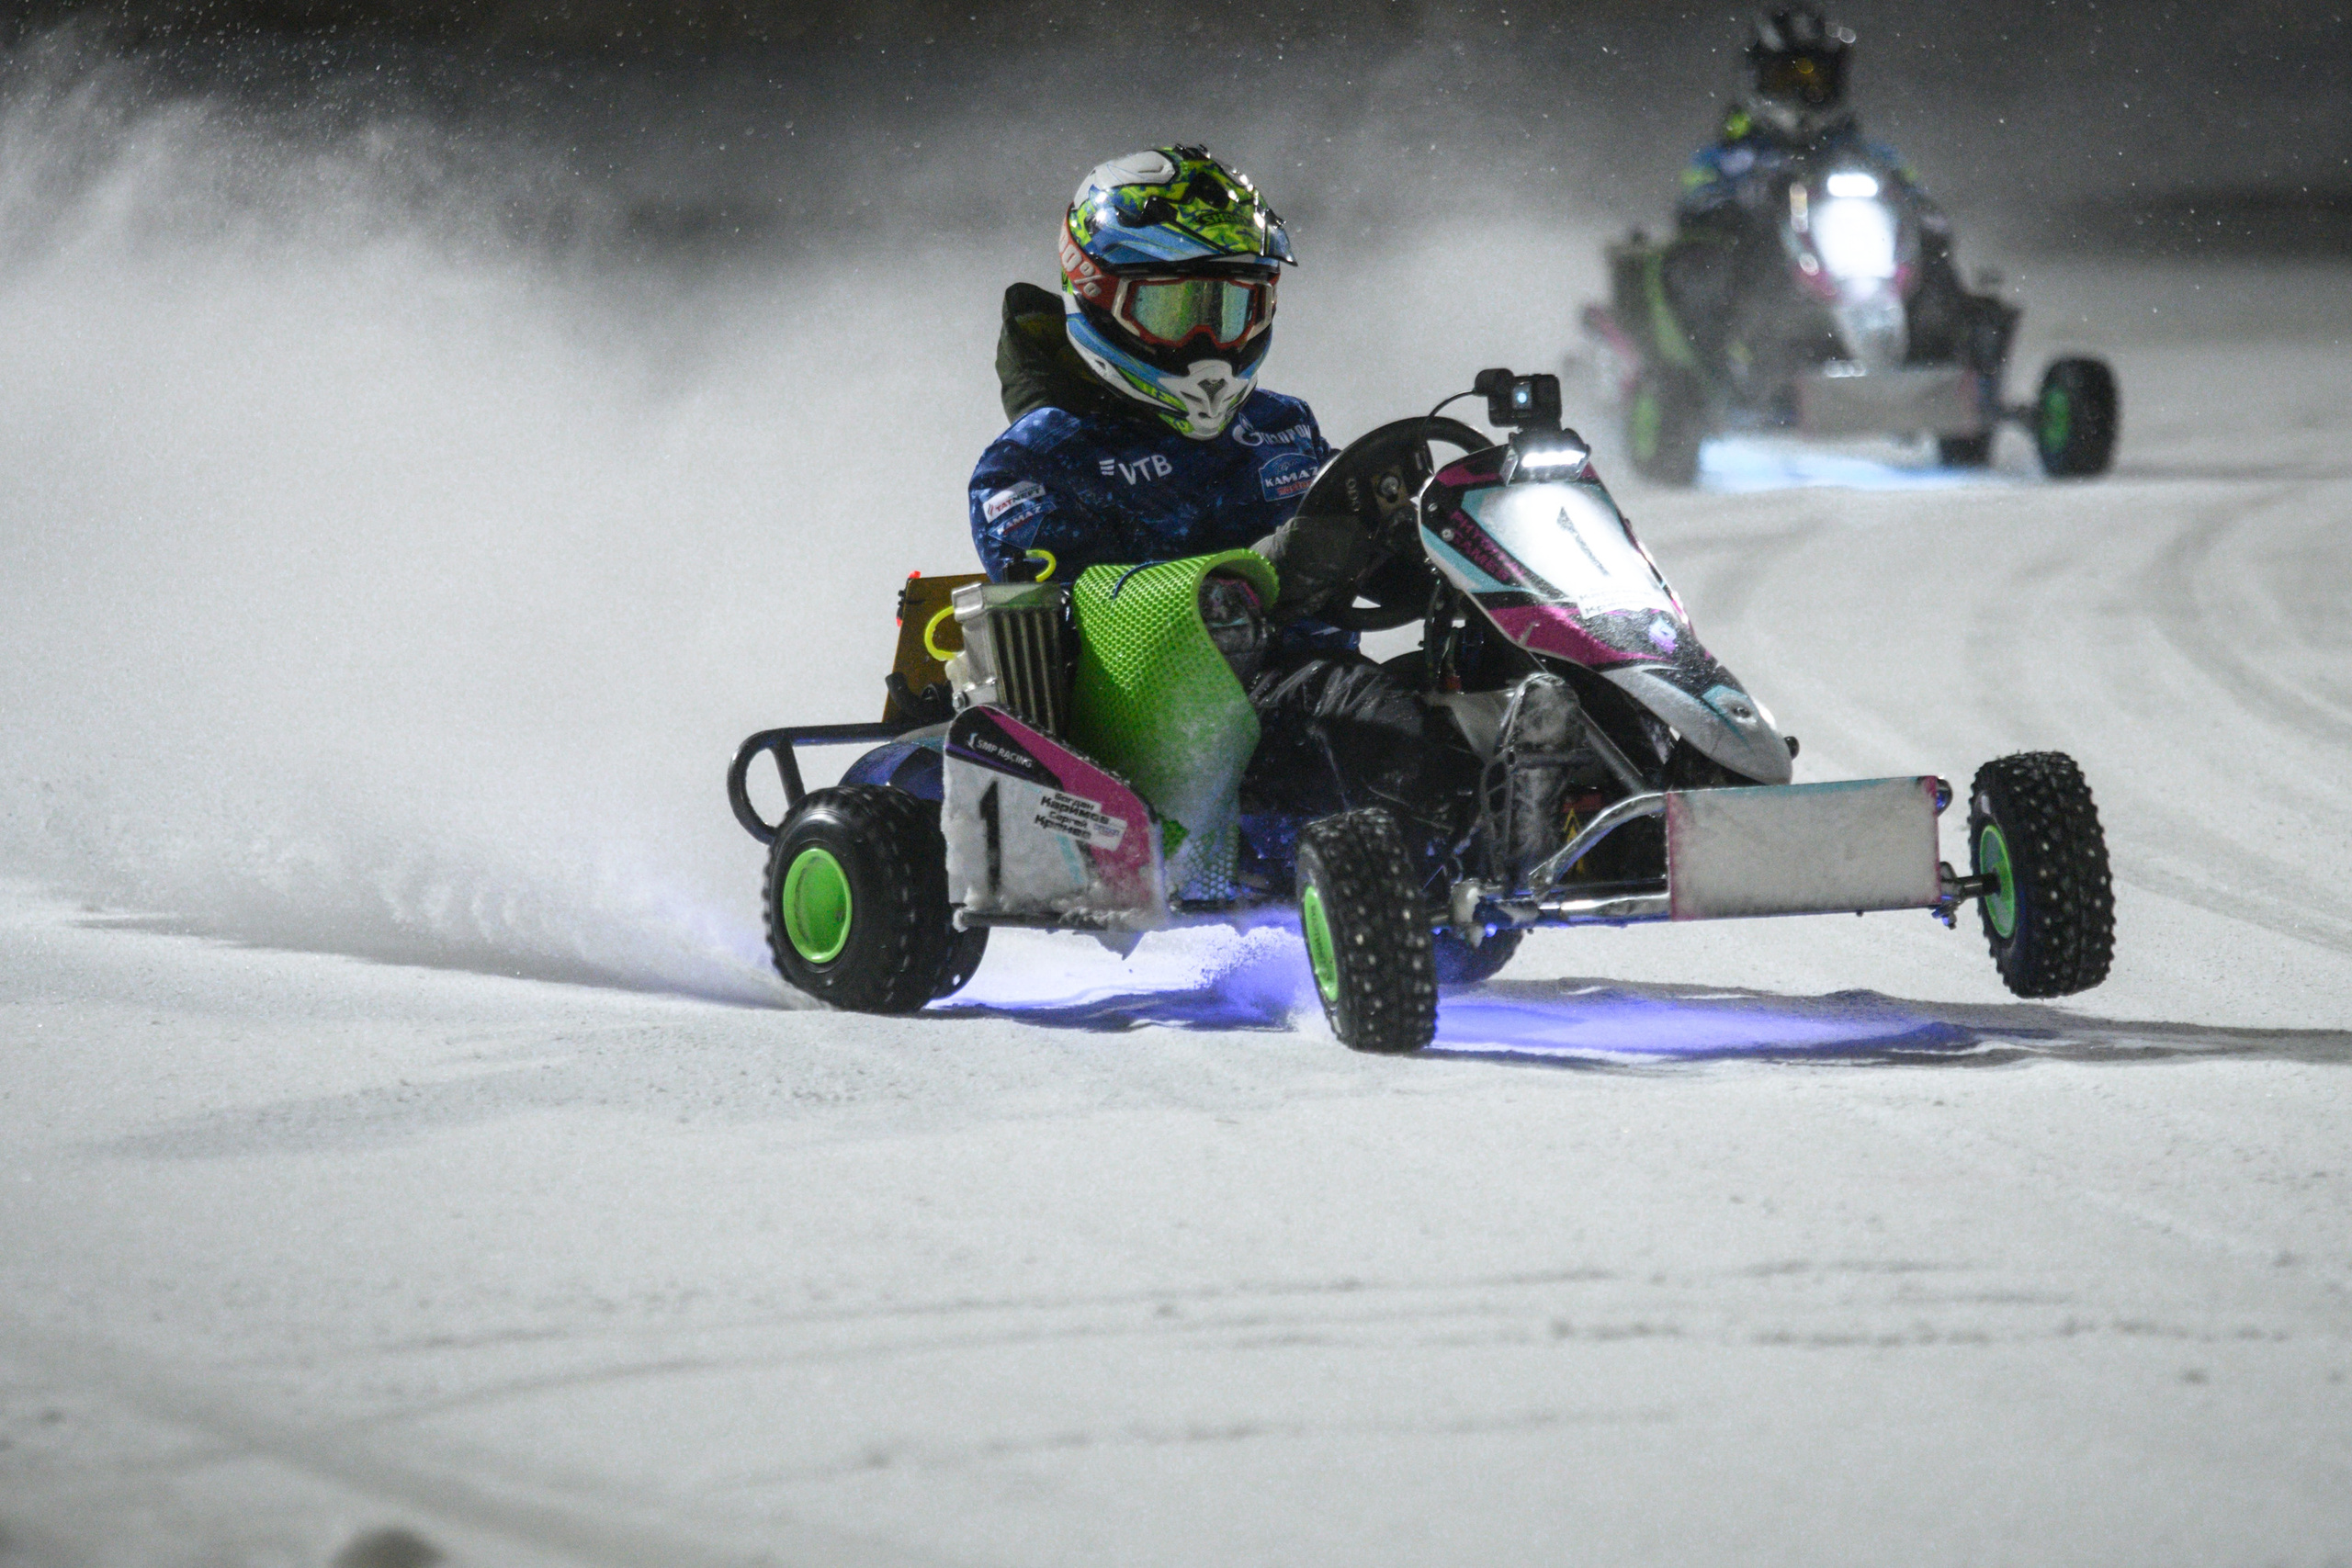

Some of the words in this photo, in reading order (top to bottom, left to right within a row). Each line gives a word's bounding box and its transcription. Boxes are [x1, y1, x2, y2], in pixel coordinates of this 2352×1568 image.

[1118, 454, 1173, 485] VTB
[1264, 466, 1318, 488] KAMAZ
[976, 739, 998, 753] SMP
[997, 747, 1033, 769] RACING
[1040, 795, 1109, 825] Каримов
[978, 779, 1001, 895] 1
